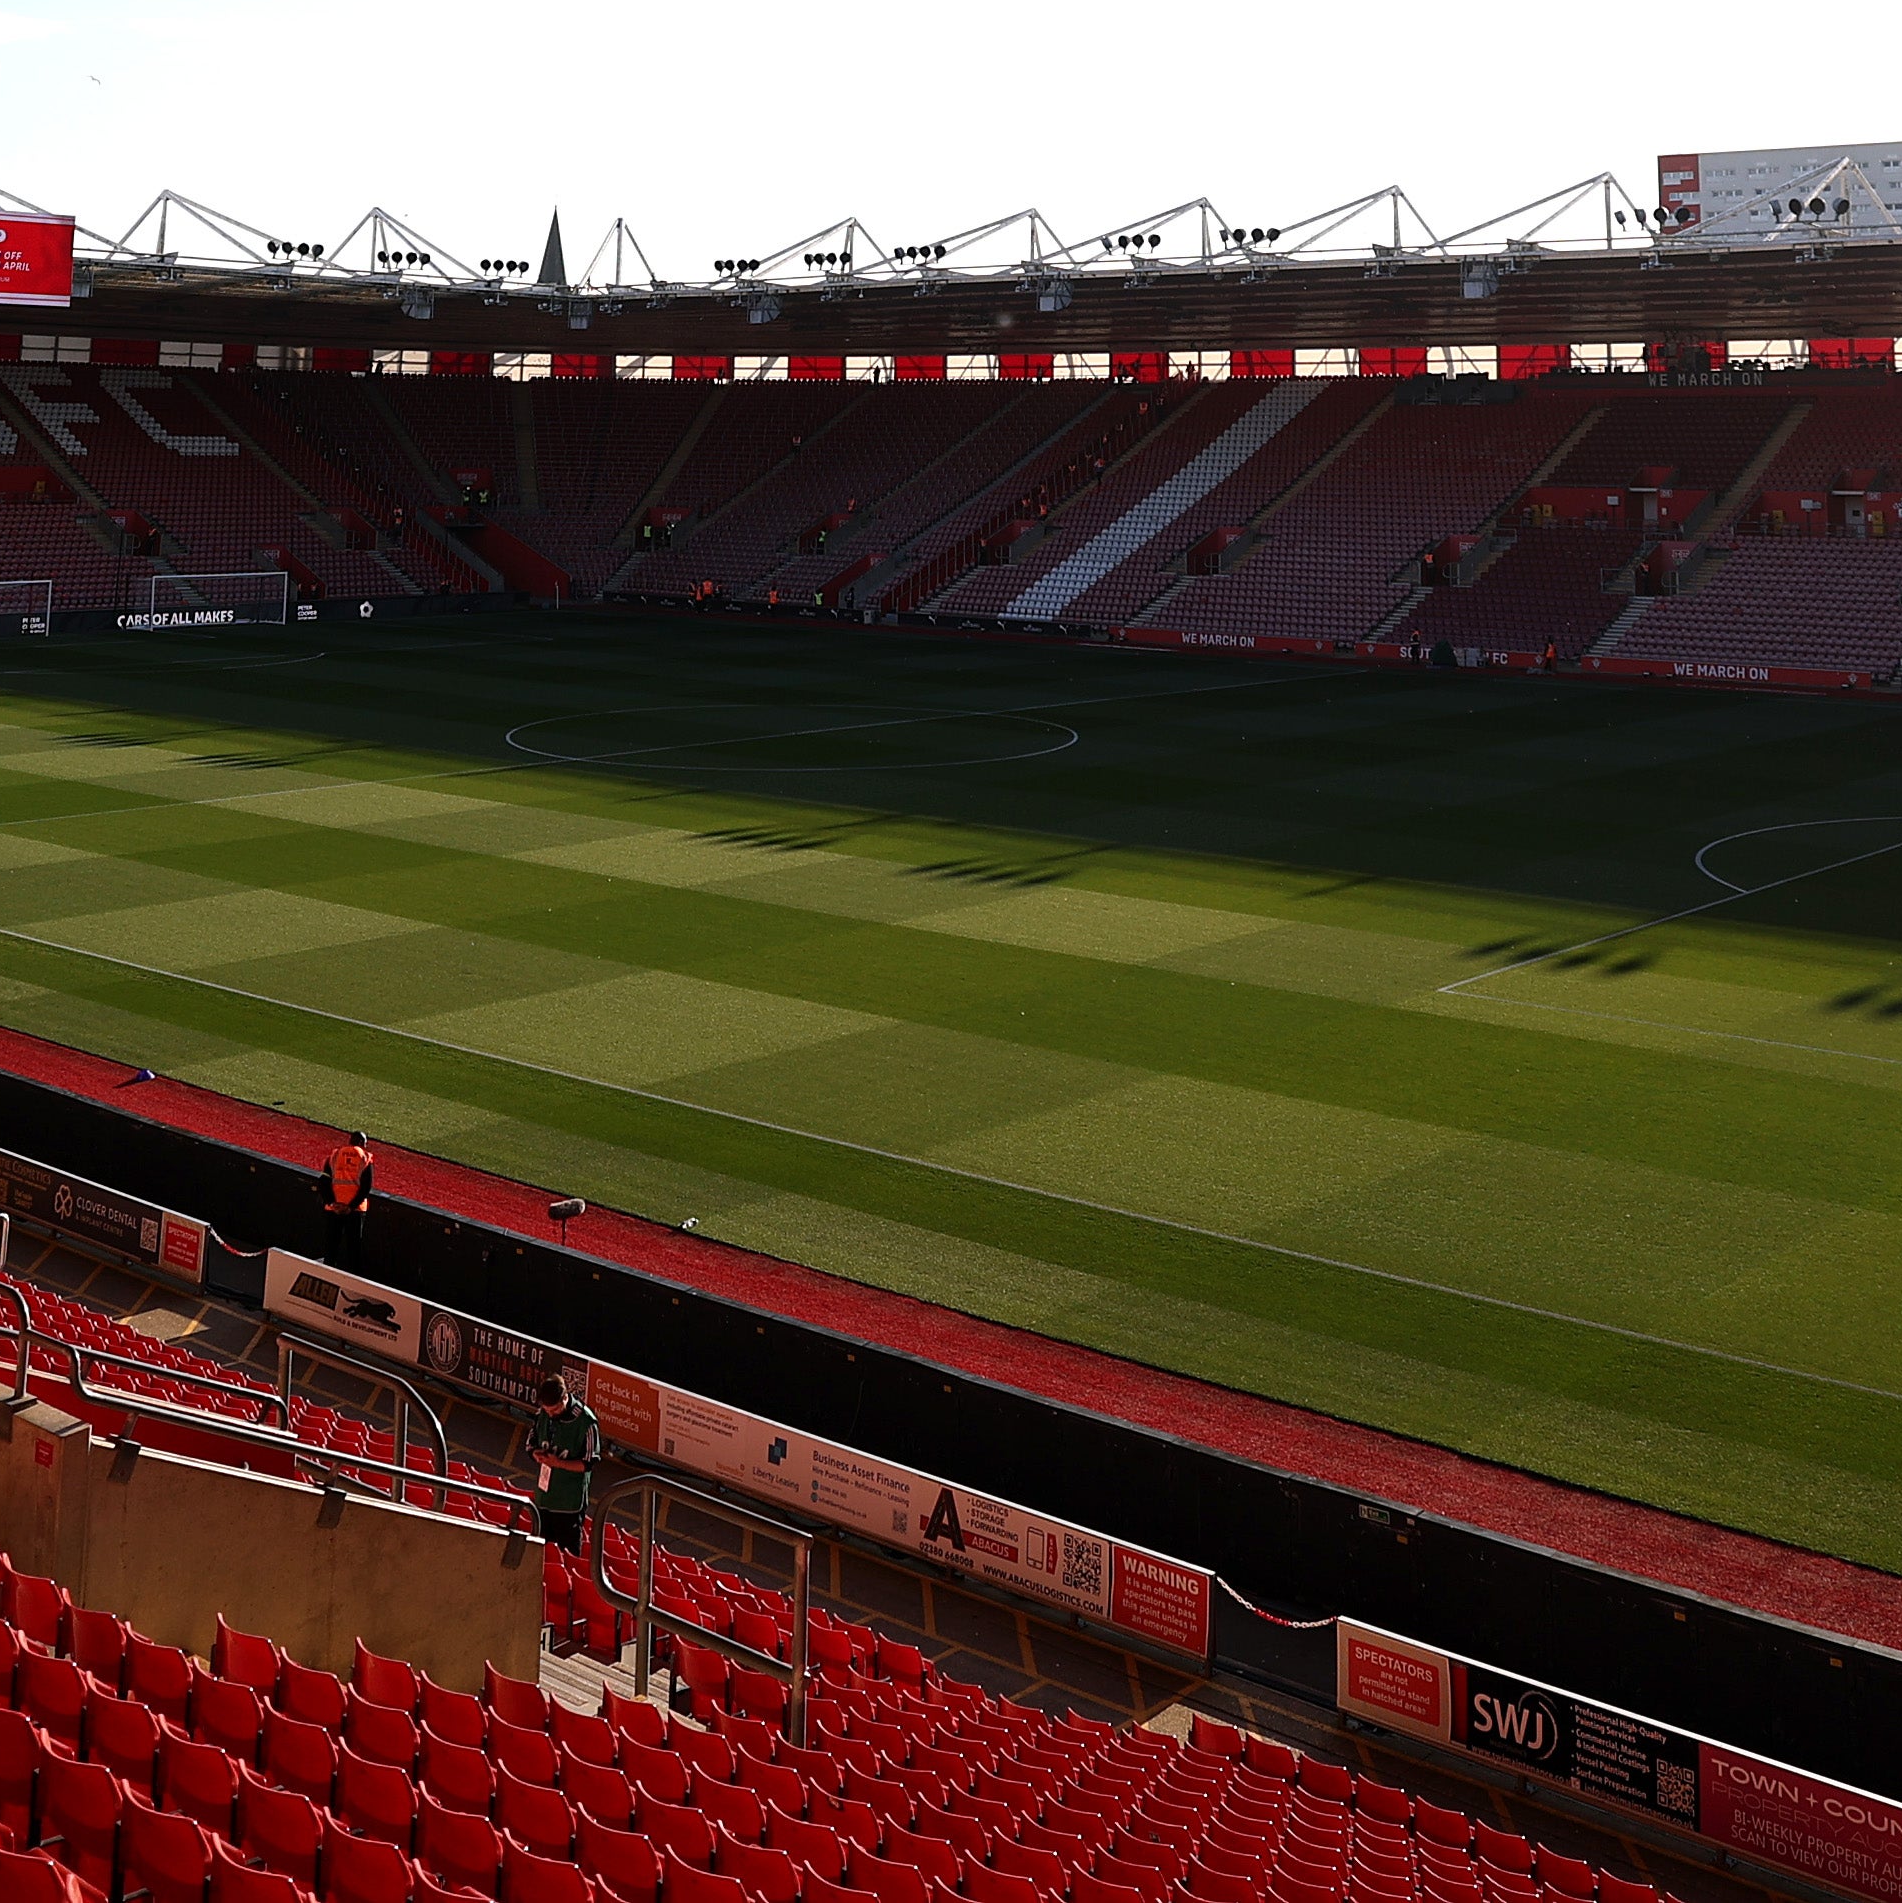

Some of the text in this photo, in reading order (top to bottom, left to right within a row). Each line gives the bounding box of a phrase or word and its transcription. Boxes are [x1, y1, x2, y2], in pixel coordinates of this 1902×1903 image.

[3, 261, 30, 272] APRIL
[4, 251, 22, 260] OFF
[1648, 372, 1763, 387] WE MARCH ON
[116, 610, 234, 630] CARS OF ALL MAKES
[1181, 632, 1255, 648] WE MARCH ON
[1493, 651, 1508, 665] FC
[1673, 662, 1769, 681] WE MARCH ON
[76, 1196, 138, 1230] CLOVER DENTAL
[292, 1274, 338, 1309] ALLEN
[334, 1315, 346, 1325] BUILD
[352, 1321, 387, 1339] DEVELOPMENT
[388, 1333, 397, 1342] LTD
[469, 1345, 514, 1375] MARTIAL
[473, 1327, 493, 1348] THE
[497, 1336, 526, 1360] HOME
[531, 1348, 545, 1365] OF
[468, 1365, 538, 1405] SOUTHAMPTO
[595, 1378, 640, 1403] Get back in
[595, 1393, 652, 1423] the game with
[595, 1406, 640, 1433] Newmedica
[752, 1466, 775, 1483] Liberty
[775, 1473, 800, 1493] Leasing
[812, 1450, 910, 1494] Business Asset Finance
[812, 1465, 823, 1477] Hire
[824, 1469, 849, 1485] Purchase
[854, 1479, 882, 1497] Refinance
[887, 1492, 910, 1508] Leasing
[923, 1487, 966, 1553] A
[970, 1508, 1006, 1527] STORAGE
[971, 1499, 1009, 1518] LOGISTICS
[970, 1519, 1019, 1543] FORWARDING
[919, 1541, 974, 1568] 02380 668008
[972, 1536, 1011, 1557] ABACUS
[982, 1563, 1104, 1616] WWW.ABACUSLOGISTICS.COM
[1122, 1555, 1199, 1596] WARNING
[1124, 1588, 1197, 1621] spectators to pass
[1126, 1575, 1196, 1608] It is an offence for
[1122, 1598, 1198, 1633] this point unless in
[1131, 1614, 1188, 1643] an emergency
[1355, 1646, 1434, 1683] SPECTATORS
[1380, 1671, 1409, 1686] are not
[1358, 1675, 1430, 1705] permitted to stand
[1362, 1686, 1427, 1715] in hatched areas
[1473, 1692, 1544, 1750] SWJ
[1574, 1704, 1667, 1745] Professional High-Quality
[1575, 1715, 1636, 1743] Painting Services
[1575, 1728, 1648, 1761] Commercial, Marine
[1582, 1741, 1617, 1761] Industrial
[1618, 1754, 1651, 1774] Coatings
[1575, 1753, 1630, 1781] Vessel Painting
[1711, 1758, 1799, 1803] TOWN
[1576, 1766, 1647, 1800] Surface Preparation
[1711, 1780, 1845, 1838] PROPERTY
[1730, 1826, 1766, 1849] SCAN
[1768, 1838, 1787, 1856] TO
[1790, 1844, 1825, 1870] VIEW
[1827, 1859, 1858, 1882] OUR
[1734, 1809, 1803, 1845] BI-WEEKLY
[1807, 1834, 1878, 1871] PROPERTY
